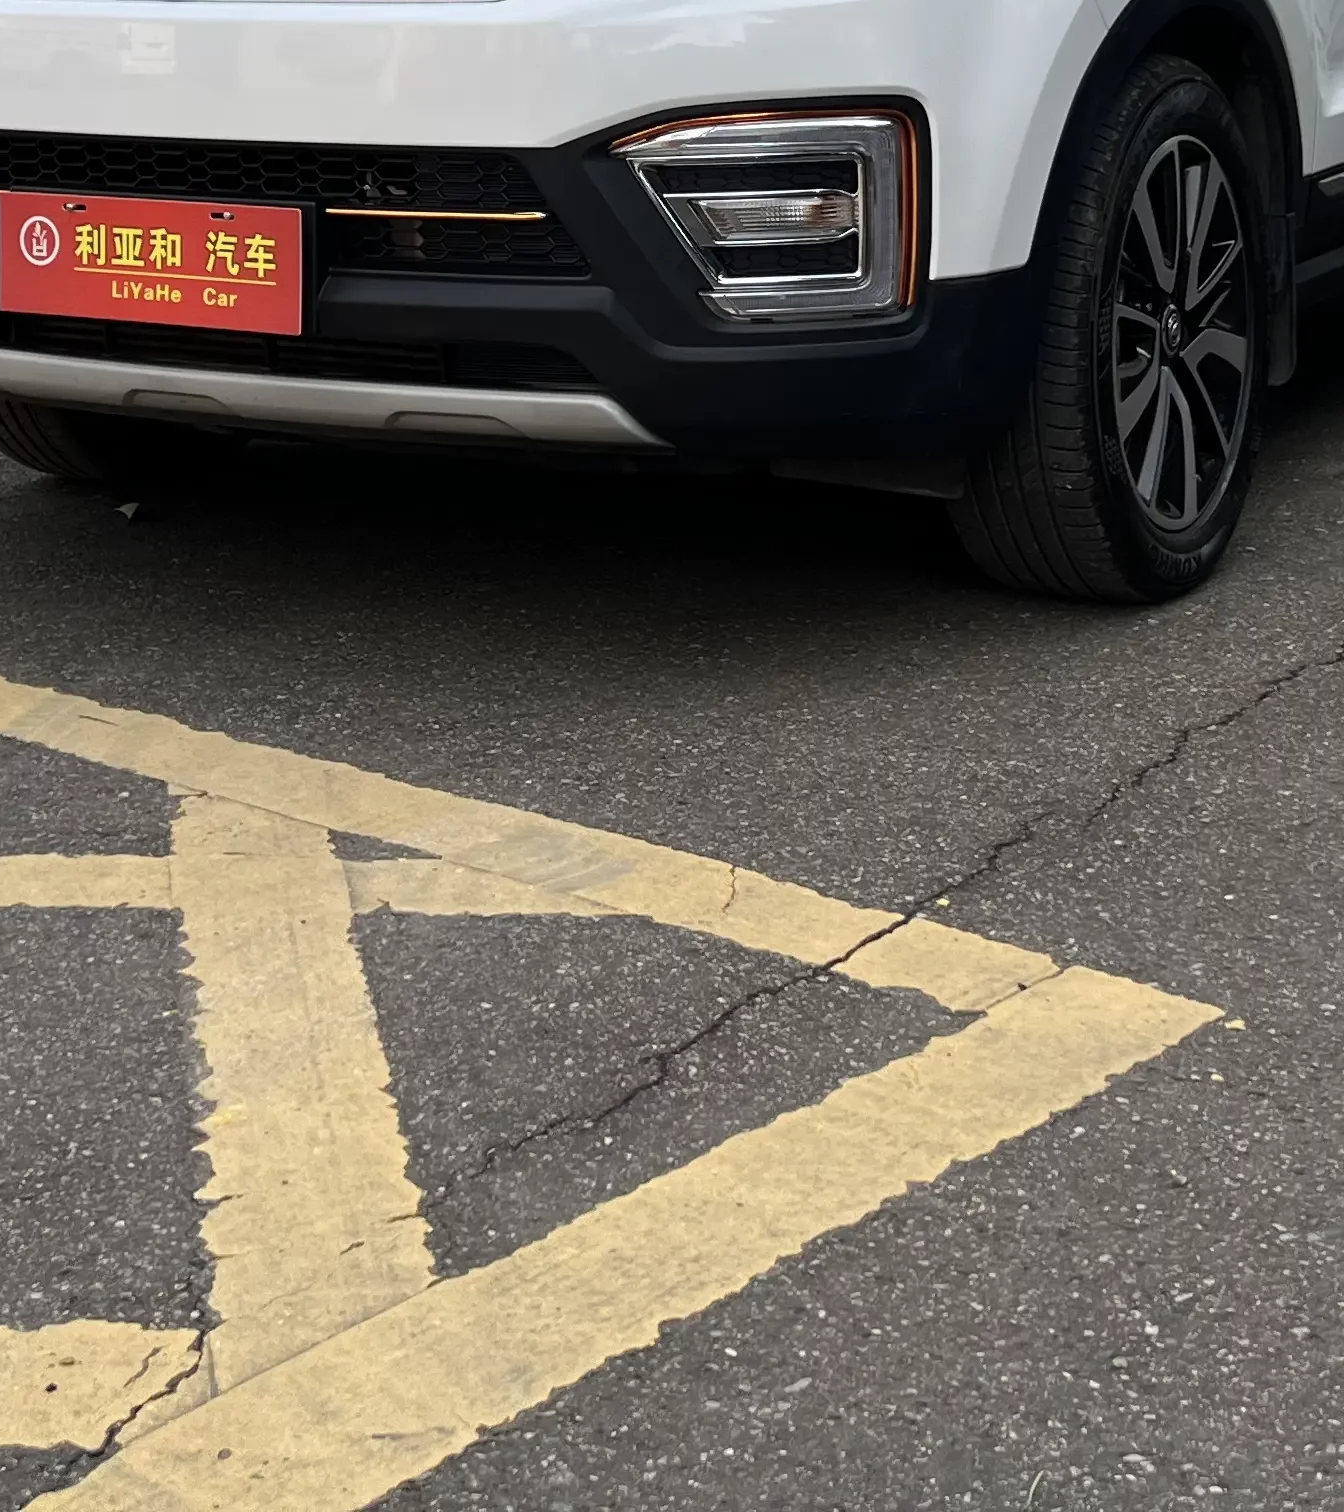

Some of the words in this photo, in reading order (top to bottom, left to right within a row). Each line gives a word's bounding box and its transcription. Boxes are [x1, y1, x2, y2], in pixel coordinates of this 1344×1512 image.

[74, 224, 182, 271] 利亚和
[205, 231, 277, 278] 汽车
[111, 280, 182, 304] LiYaHe
[202, 287, 238, 307] Car
